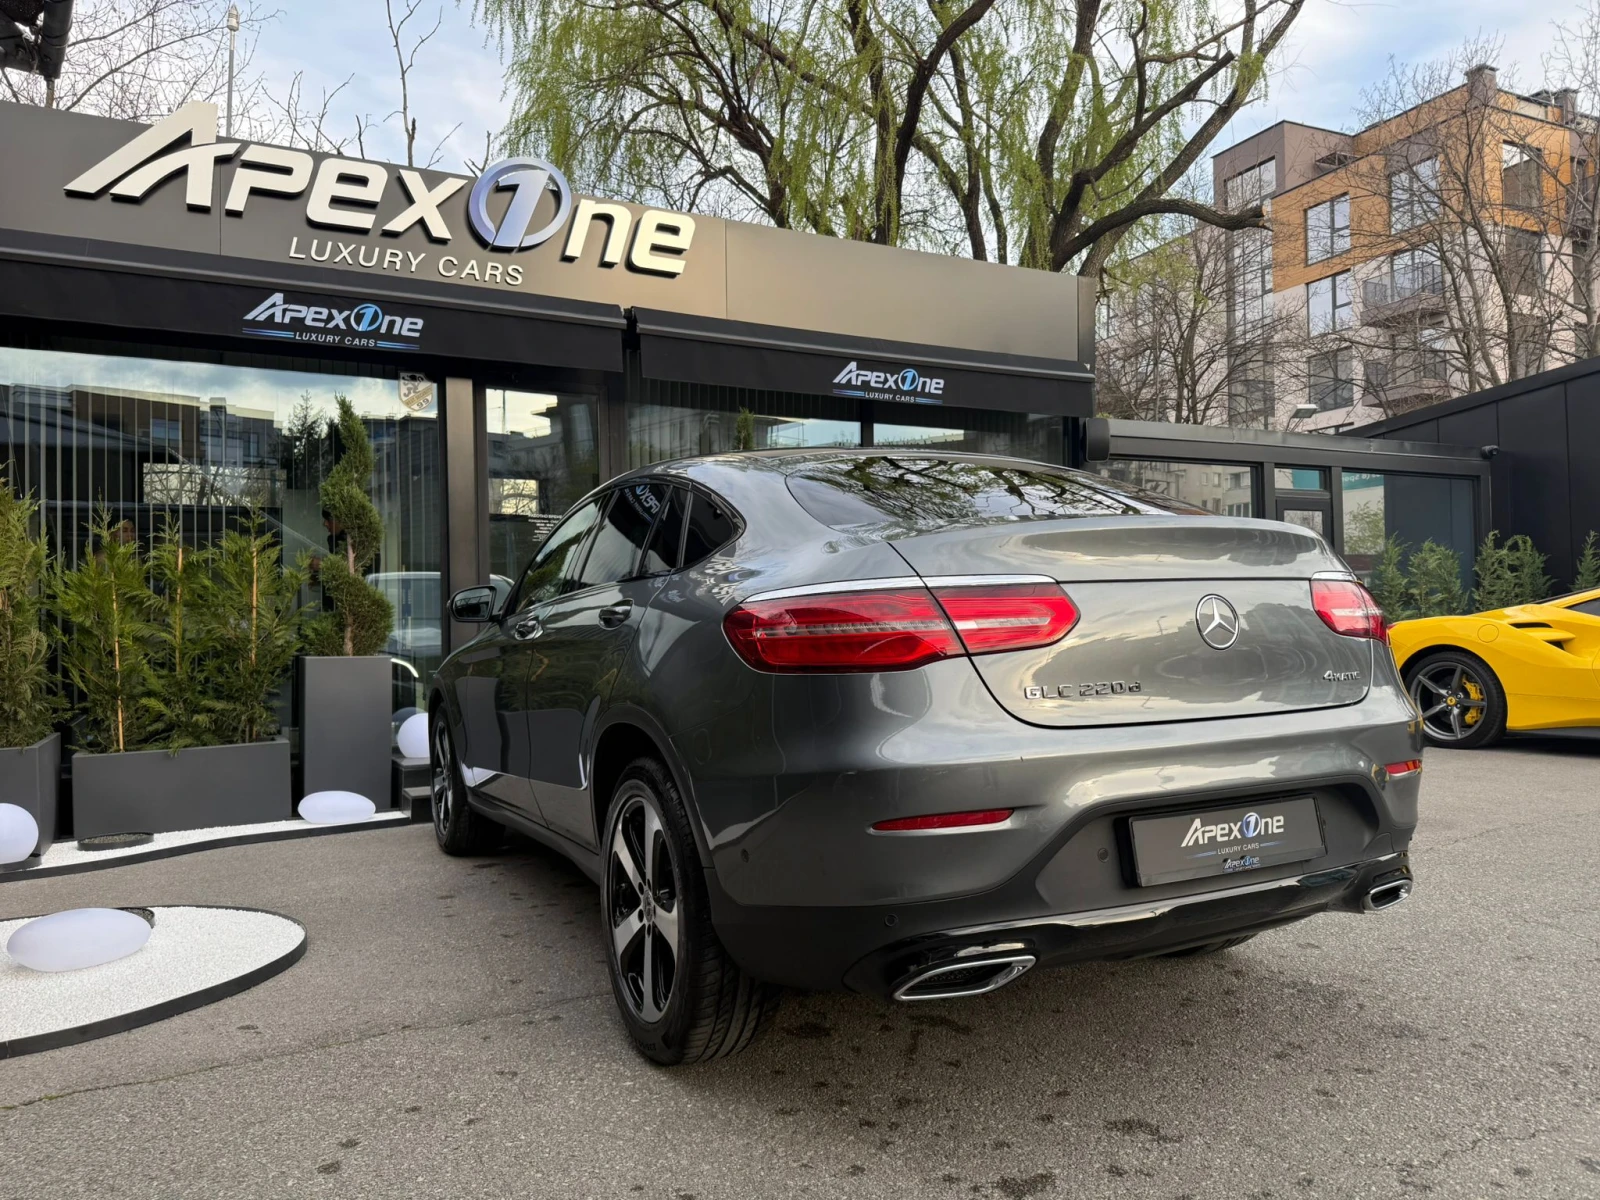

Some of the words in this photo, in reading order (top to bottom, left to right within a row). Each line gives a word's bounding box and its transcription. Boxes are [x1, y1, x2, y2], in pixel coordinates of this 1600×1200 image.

[288, 236, 427, 273] LUXURY
[437, 255, 525, 286] CARS
[295, 332, 341, 344] LUXURY
[344, 336, 376, 348] CARS
[865, 391, 894, 401] LUXURY
[895, 394, 915, 403] CARS
[1322, 670, 1361, 681] 4MATIC
[1024, 684, 1074, 700] GLC
[1217, 844, 1242, 855] LUXURY
[1242, 842, 1260, 851] CARS
